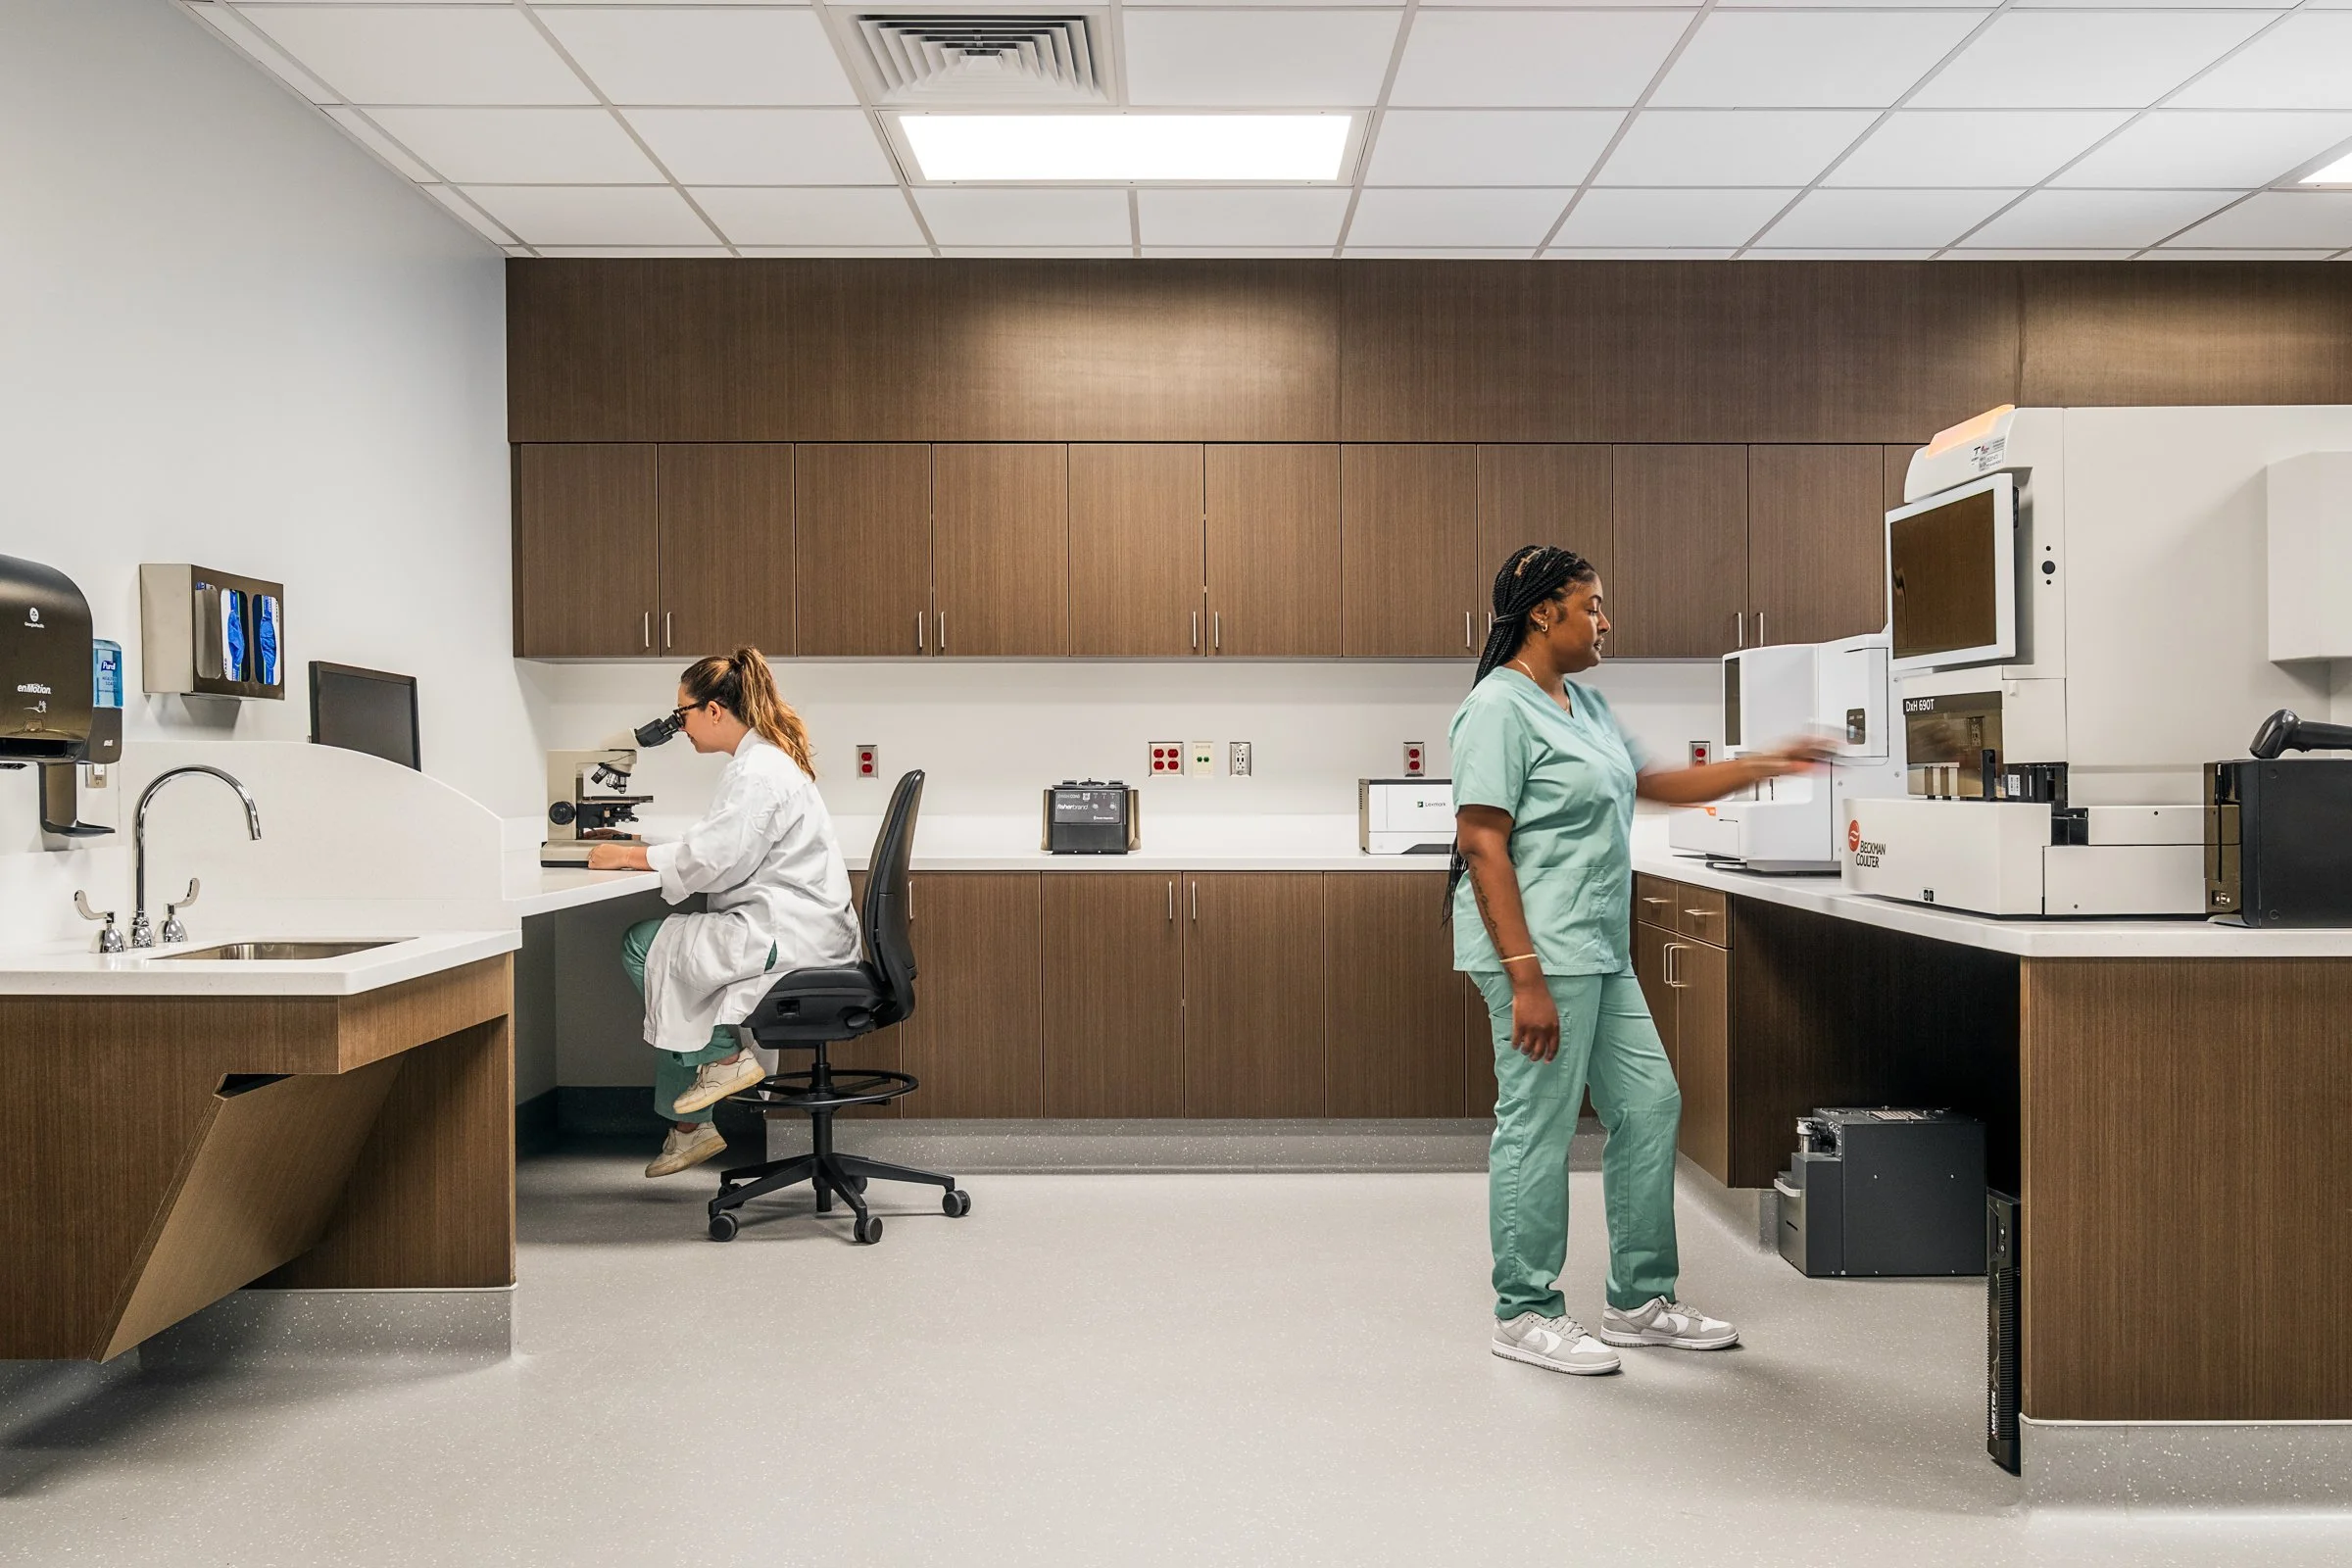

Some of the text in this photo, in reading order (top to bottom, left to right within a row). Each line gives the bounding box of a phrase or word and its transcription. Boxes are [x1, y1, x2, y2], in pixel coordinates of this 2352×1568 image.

[17, 683, 52, 694] enMotion
[1906, 699, 1935, 711] DxH 690T
[1860, 840, 1886, 855] BECKMAN
[1855, 853, 1879, 868] COULTER
